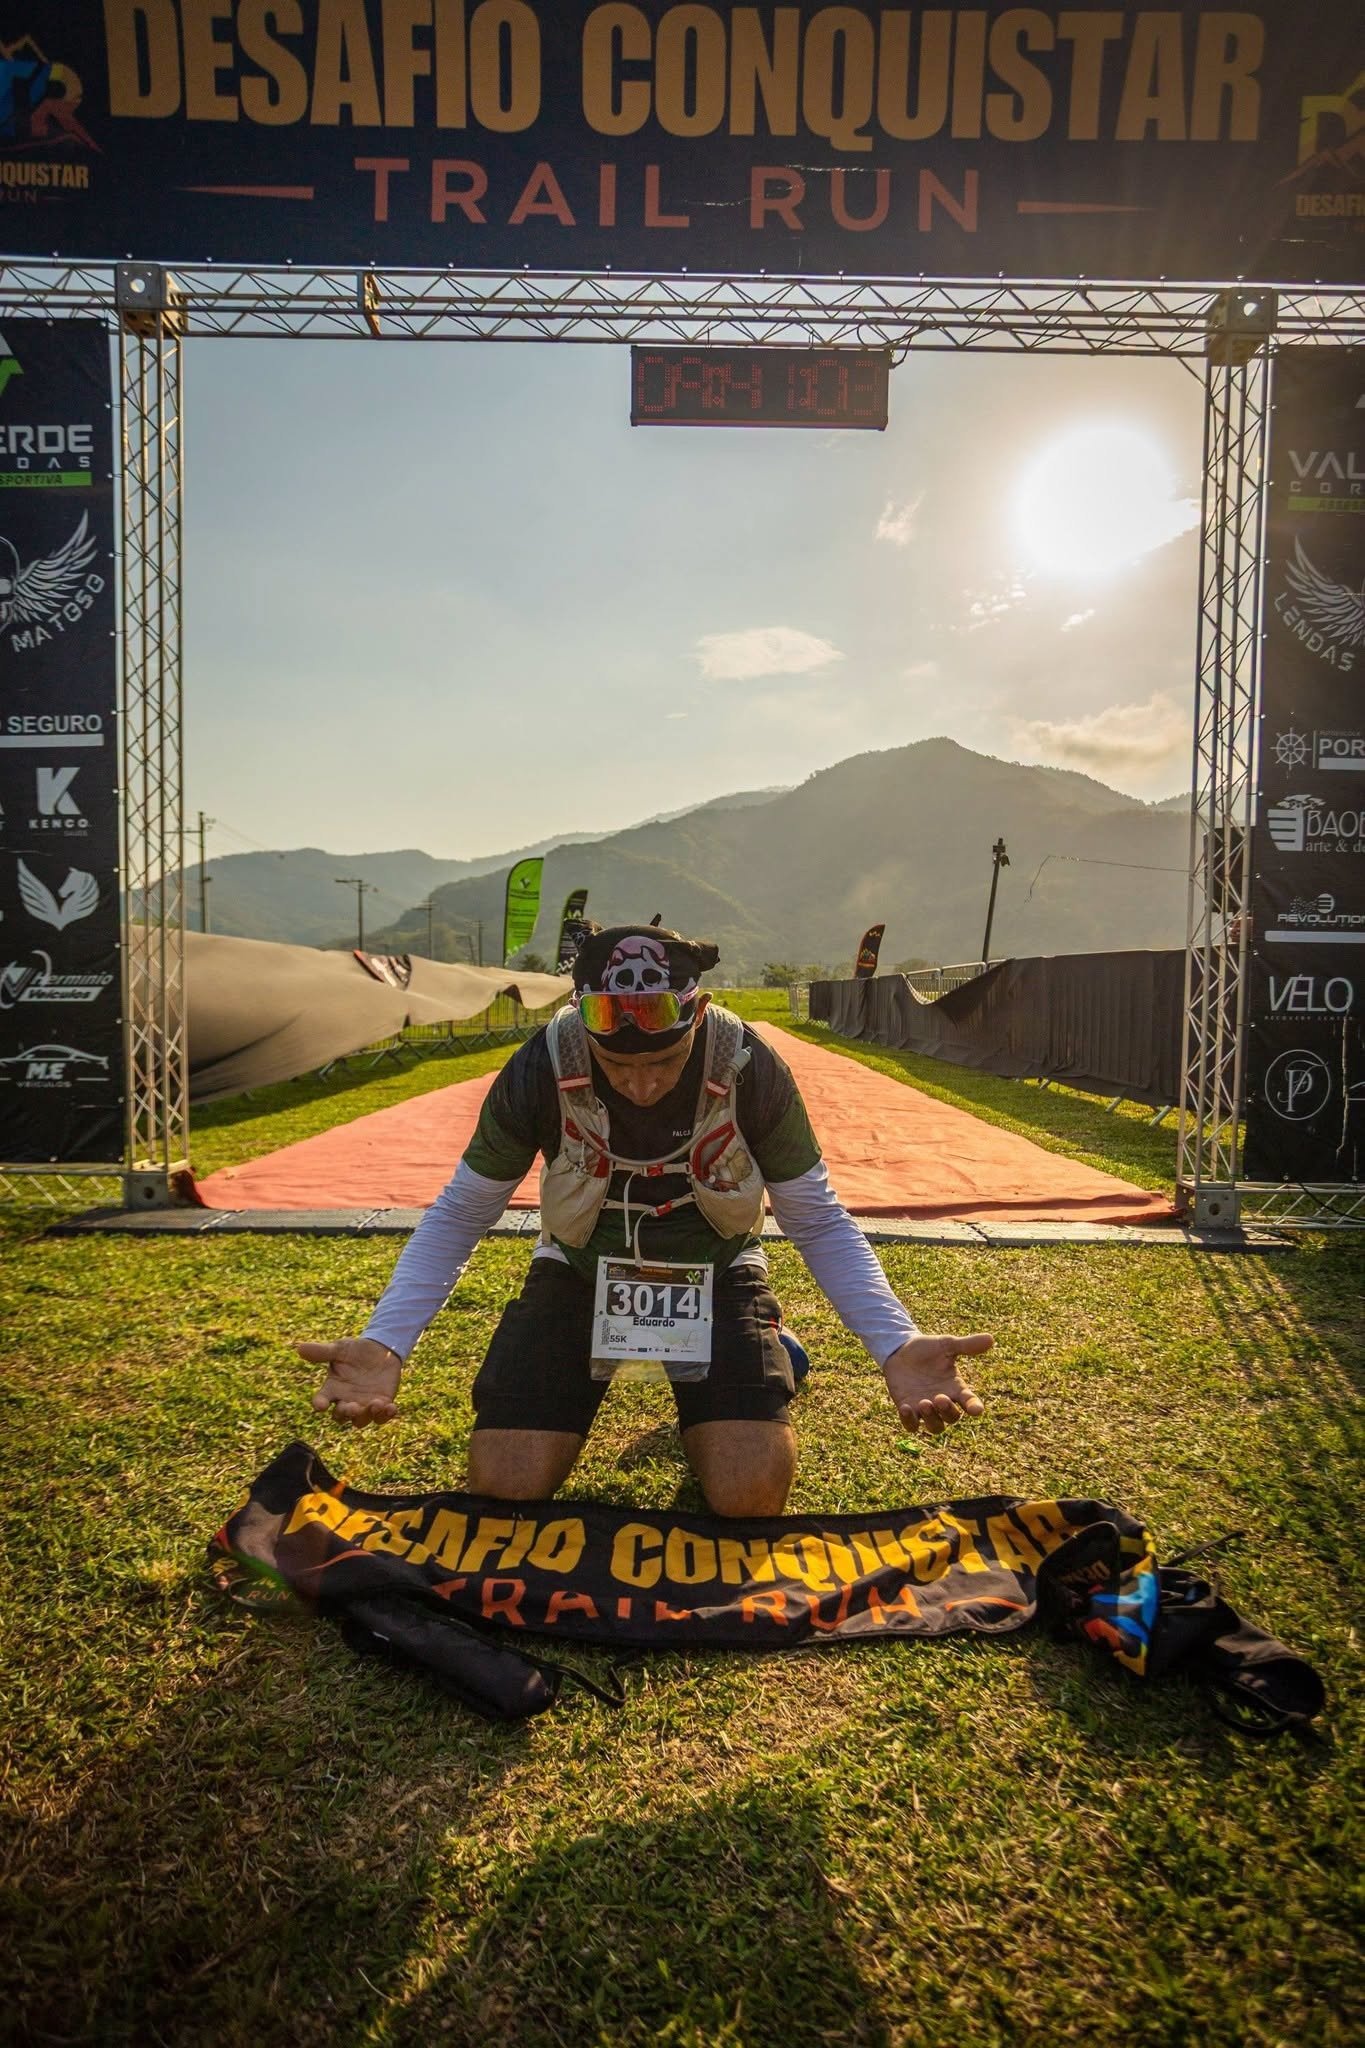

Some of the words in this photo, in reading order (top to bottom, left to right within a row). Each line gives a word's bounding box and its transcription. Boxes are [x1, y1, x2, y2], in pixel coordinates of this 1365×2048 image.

[105, 0, 541, 133] DESAFIO
[582, 3, 1265, 151] CONQUISTAR
[0, 160, 89, 190] QUISTAR
[354, 157, 690, 228] TRAIL
[749, 166, 979, 233] RUN
[11, 573, 105, 652] MATOSO
[1274, 591, 1355, 672] LENDAS
[7, 714, 103, 733] SEGURO
[36, 767, 81, 814] K
[28, 818, 89, 829] KENCO
[1306, 841, 1333, 853] arte
[1335, 839, 1347, 853] &
[610, 1283, 699, 1319] 3014
[609, 1334, 627, 1343] 55K
[632, 1317, 676, 1328] Eduardo
